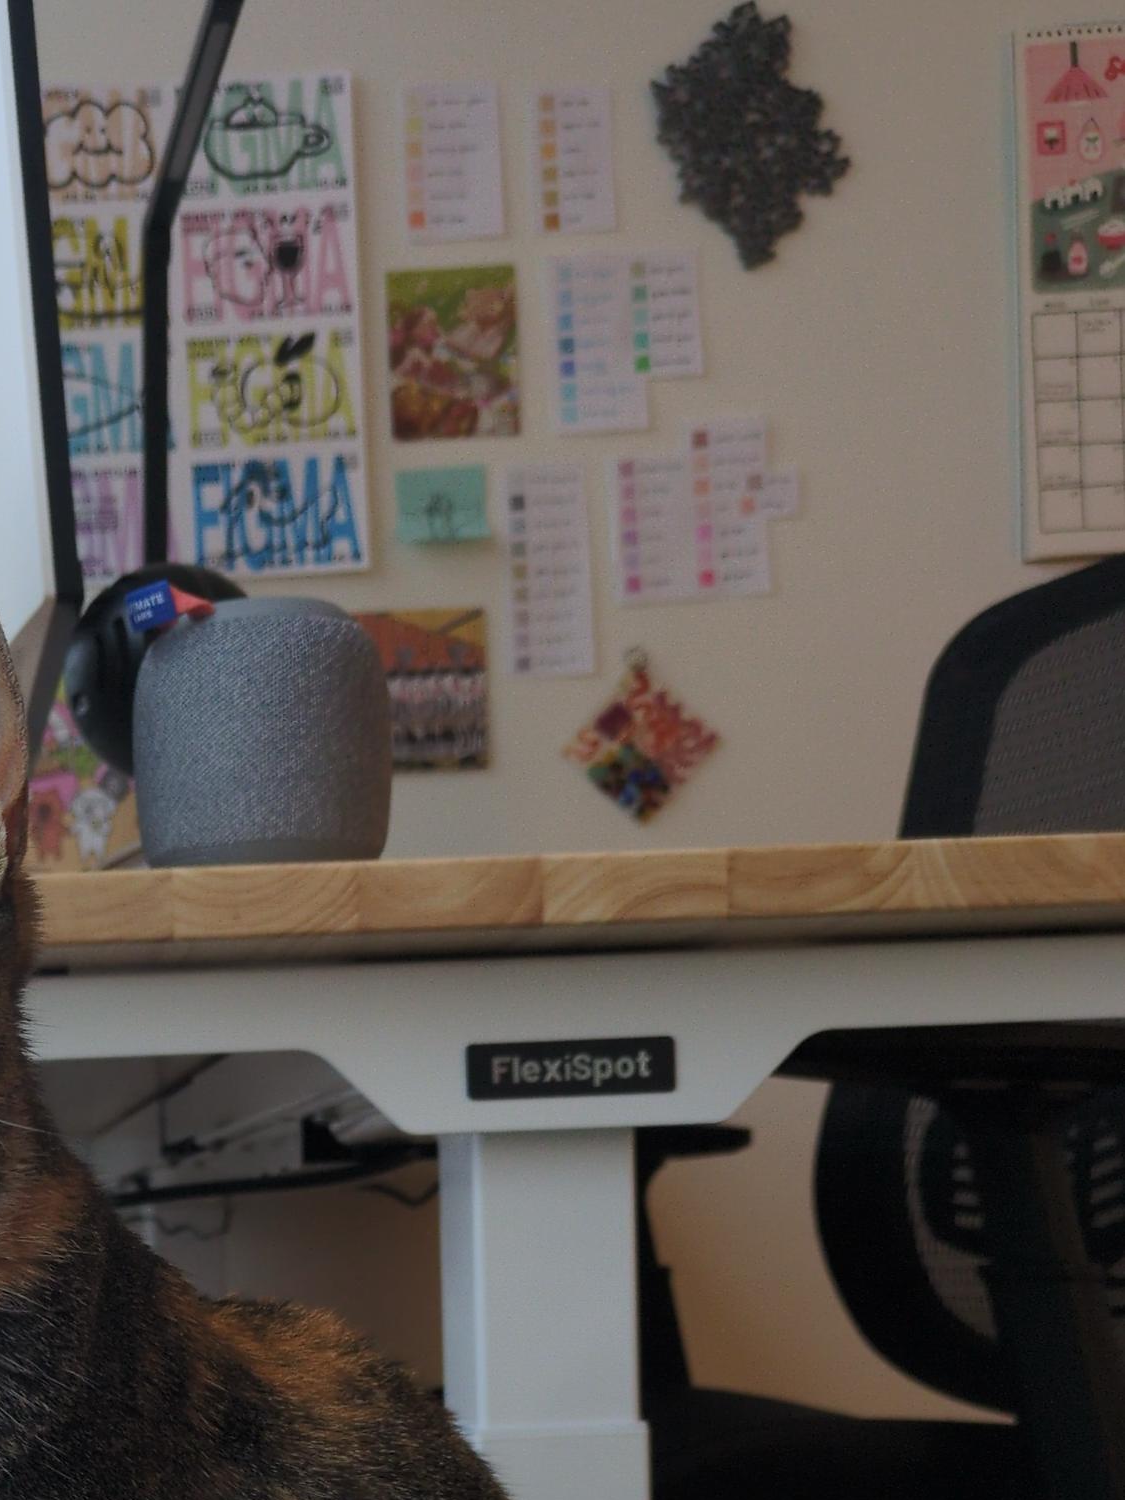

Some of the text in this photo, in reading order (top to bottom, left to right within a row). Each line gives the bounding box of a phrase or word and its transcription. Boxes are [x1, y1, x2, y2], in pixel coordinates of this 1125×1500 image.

[180, 204, 350, 326] FIGMA
[186, 328, 358, 450] FIGMA
[191, 454, 363, 573] FIGMA
[491, 1049, 652, 1088] FlexiSpot
